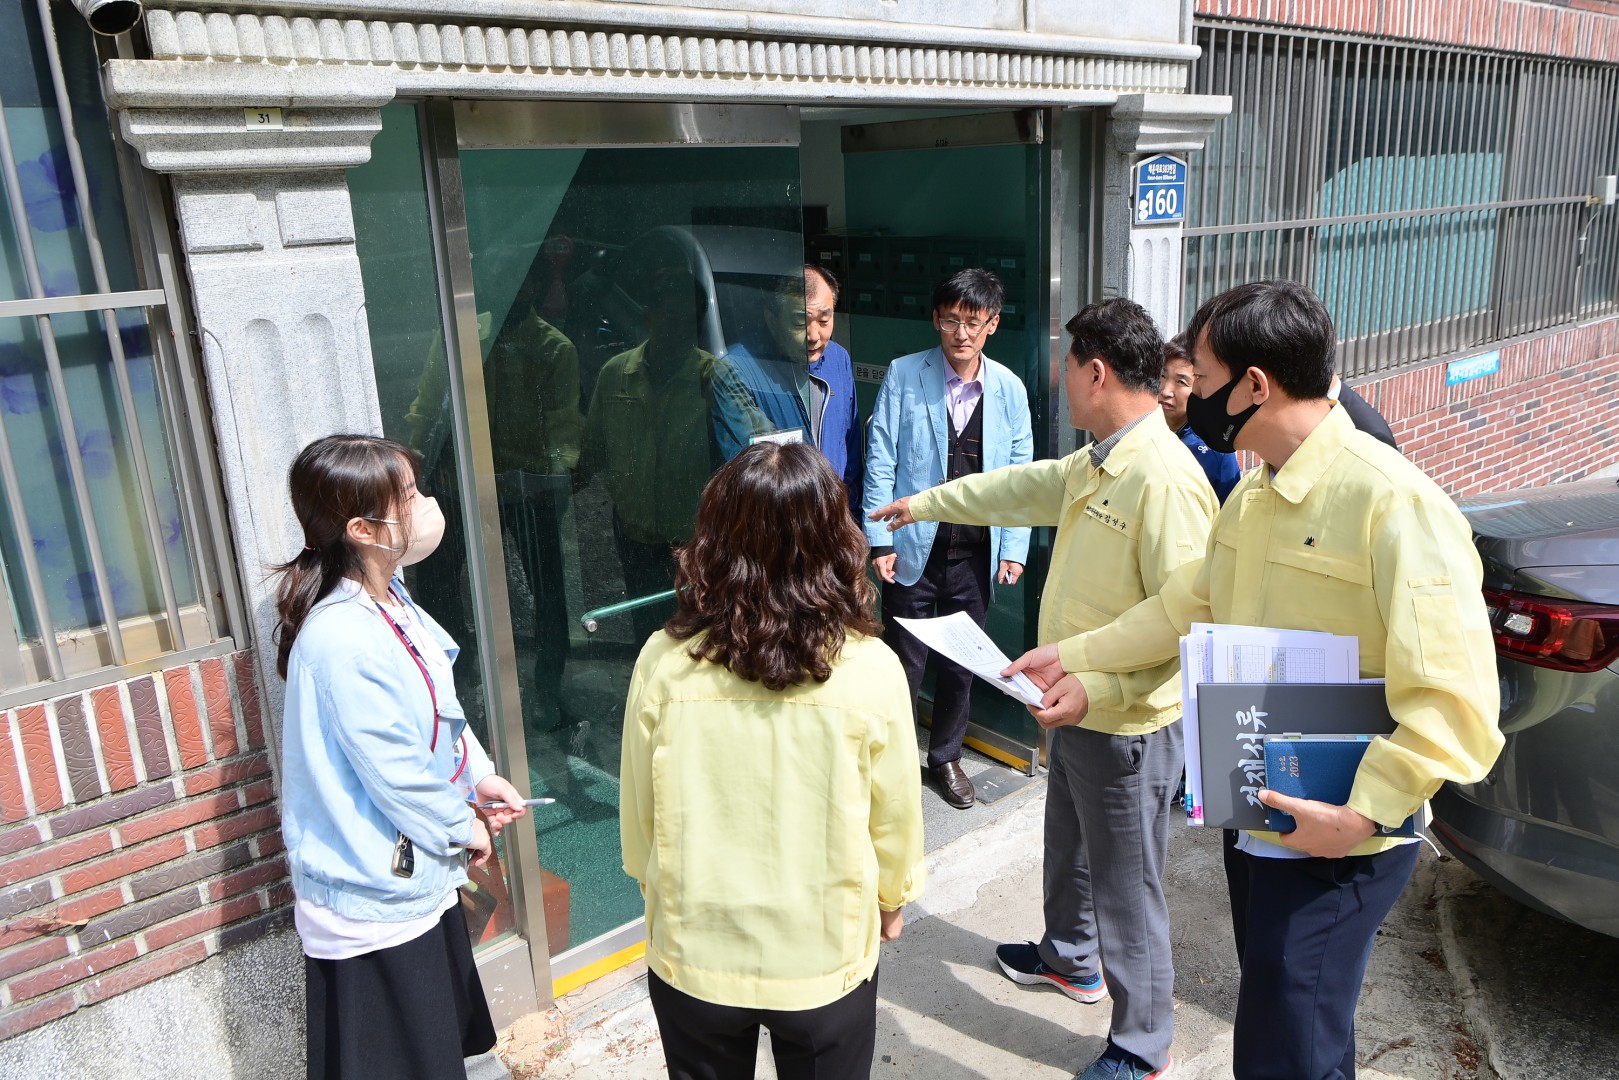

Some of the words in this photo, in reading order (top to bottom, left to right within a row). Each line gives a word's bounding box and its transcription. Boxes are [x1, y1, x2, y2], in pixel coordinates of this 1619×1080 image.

[257, 114, 270, 124] 31
[1145, 189, 1177, 215] 160
[1289, 756, 1299, 778] 2023
